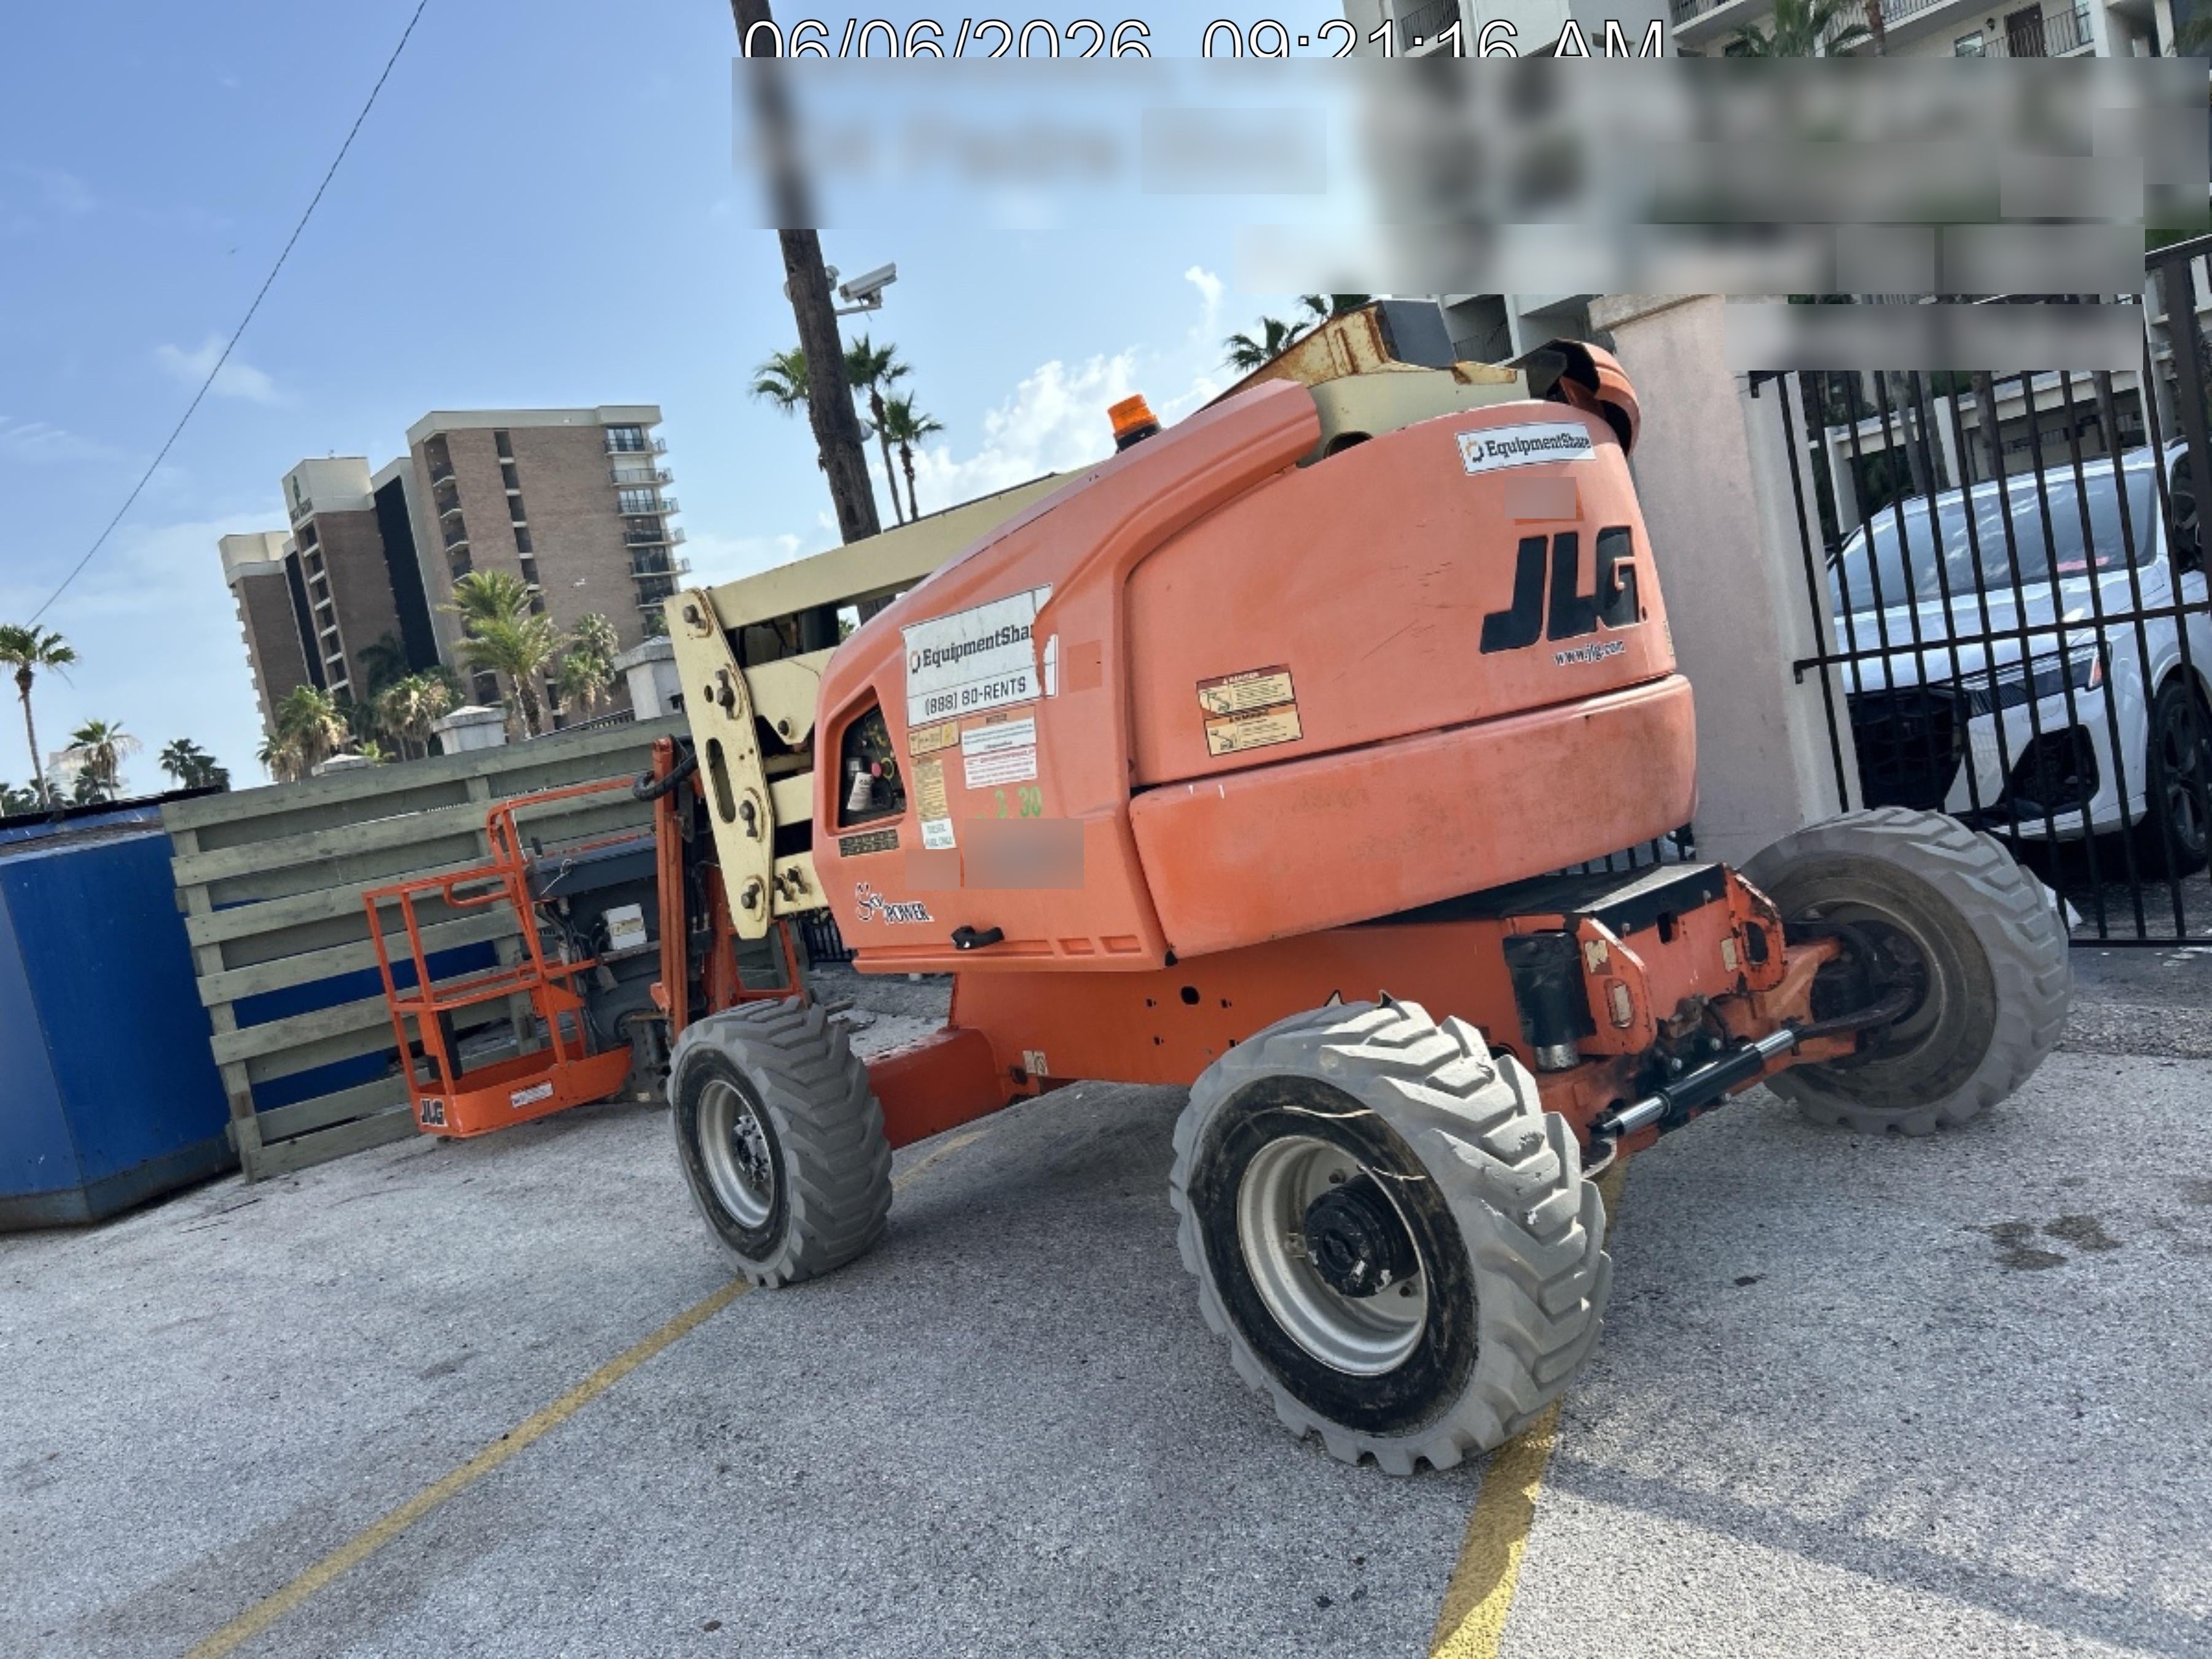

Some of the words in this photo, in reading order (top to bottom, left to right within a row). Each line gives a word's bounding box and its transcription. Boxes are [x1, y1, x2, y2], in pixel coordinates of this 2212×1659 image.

[1485, 432, 1591, 458] EquipmentShare
[1480, 526, 1640, 654] JLG
[925, 693, 957, 716] (888)
[962, 676, 1026, 706] 80-RENTS
[422, 1100, 445, 1124] JLG
